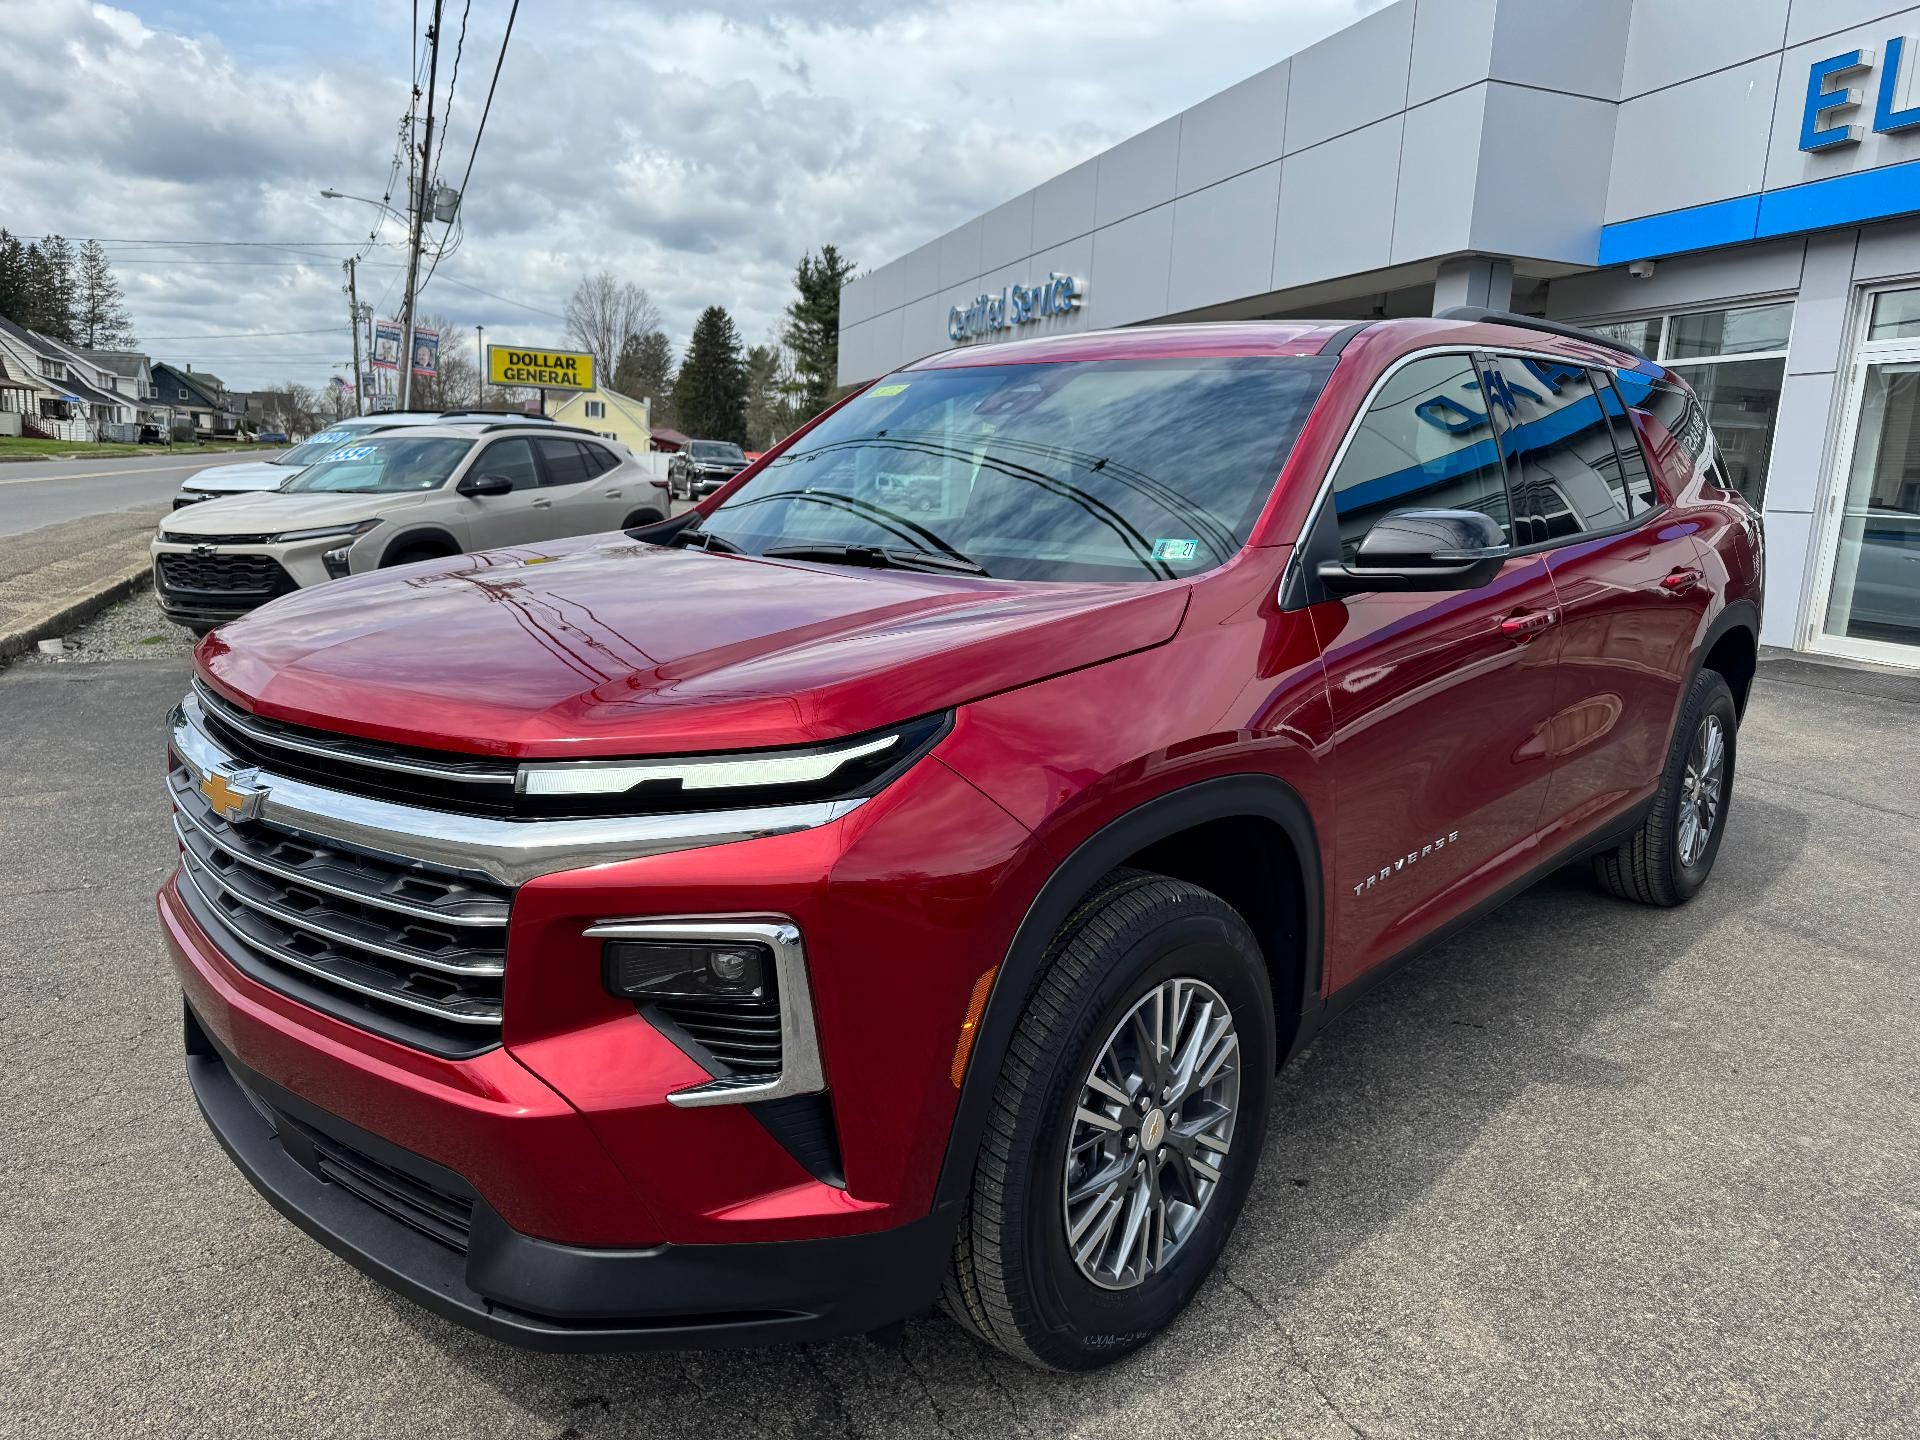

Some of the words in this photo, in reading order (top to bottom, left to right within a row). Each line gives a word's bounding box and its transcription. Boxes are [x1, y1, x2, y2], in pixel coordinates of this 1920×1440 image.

[948, 287, 1006, 340] Certified
[1010, 271, 1076, 325] Service
[508, 352, 577, 370] DOLLAR
[503, 367, 582, 385] GENERAL
[1182, 542, 1195, 557] 27
[1353, 830, 1460, 896] TRAVERSE
